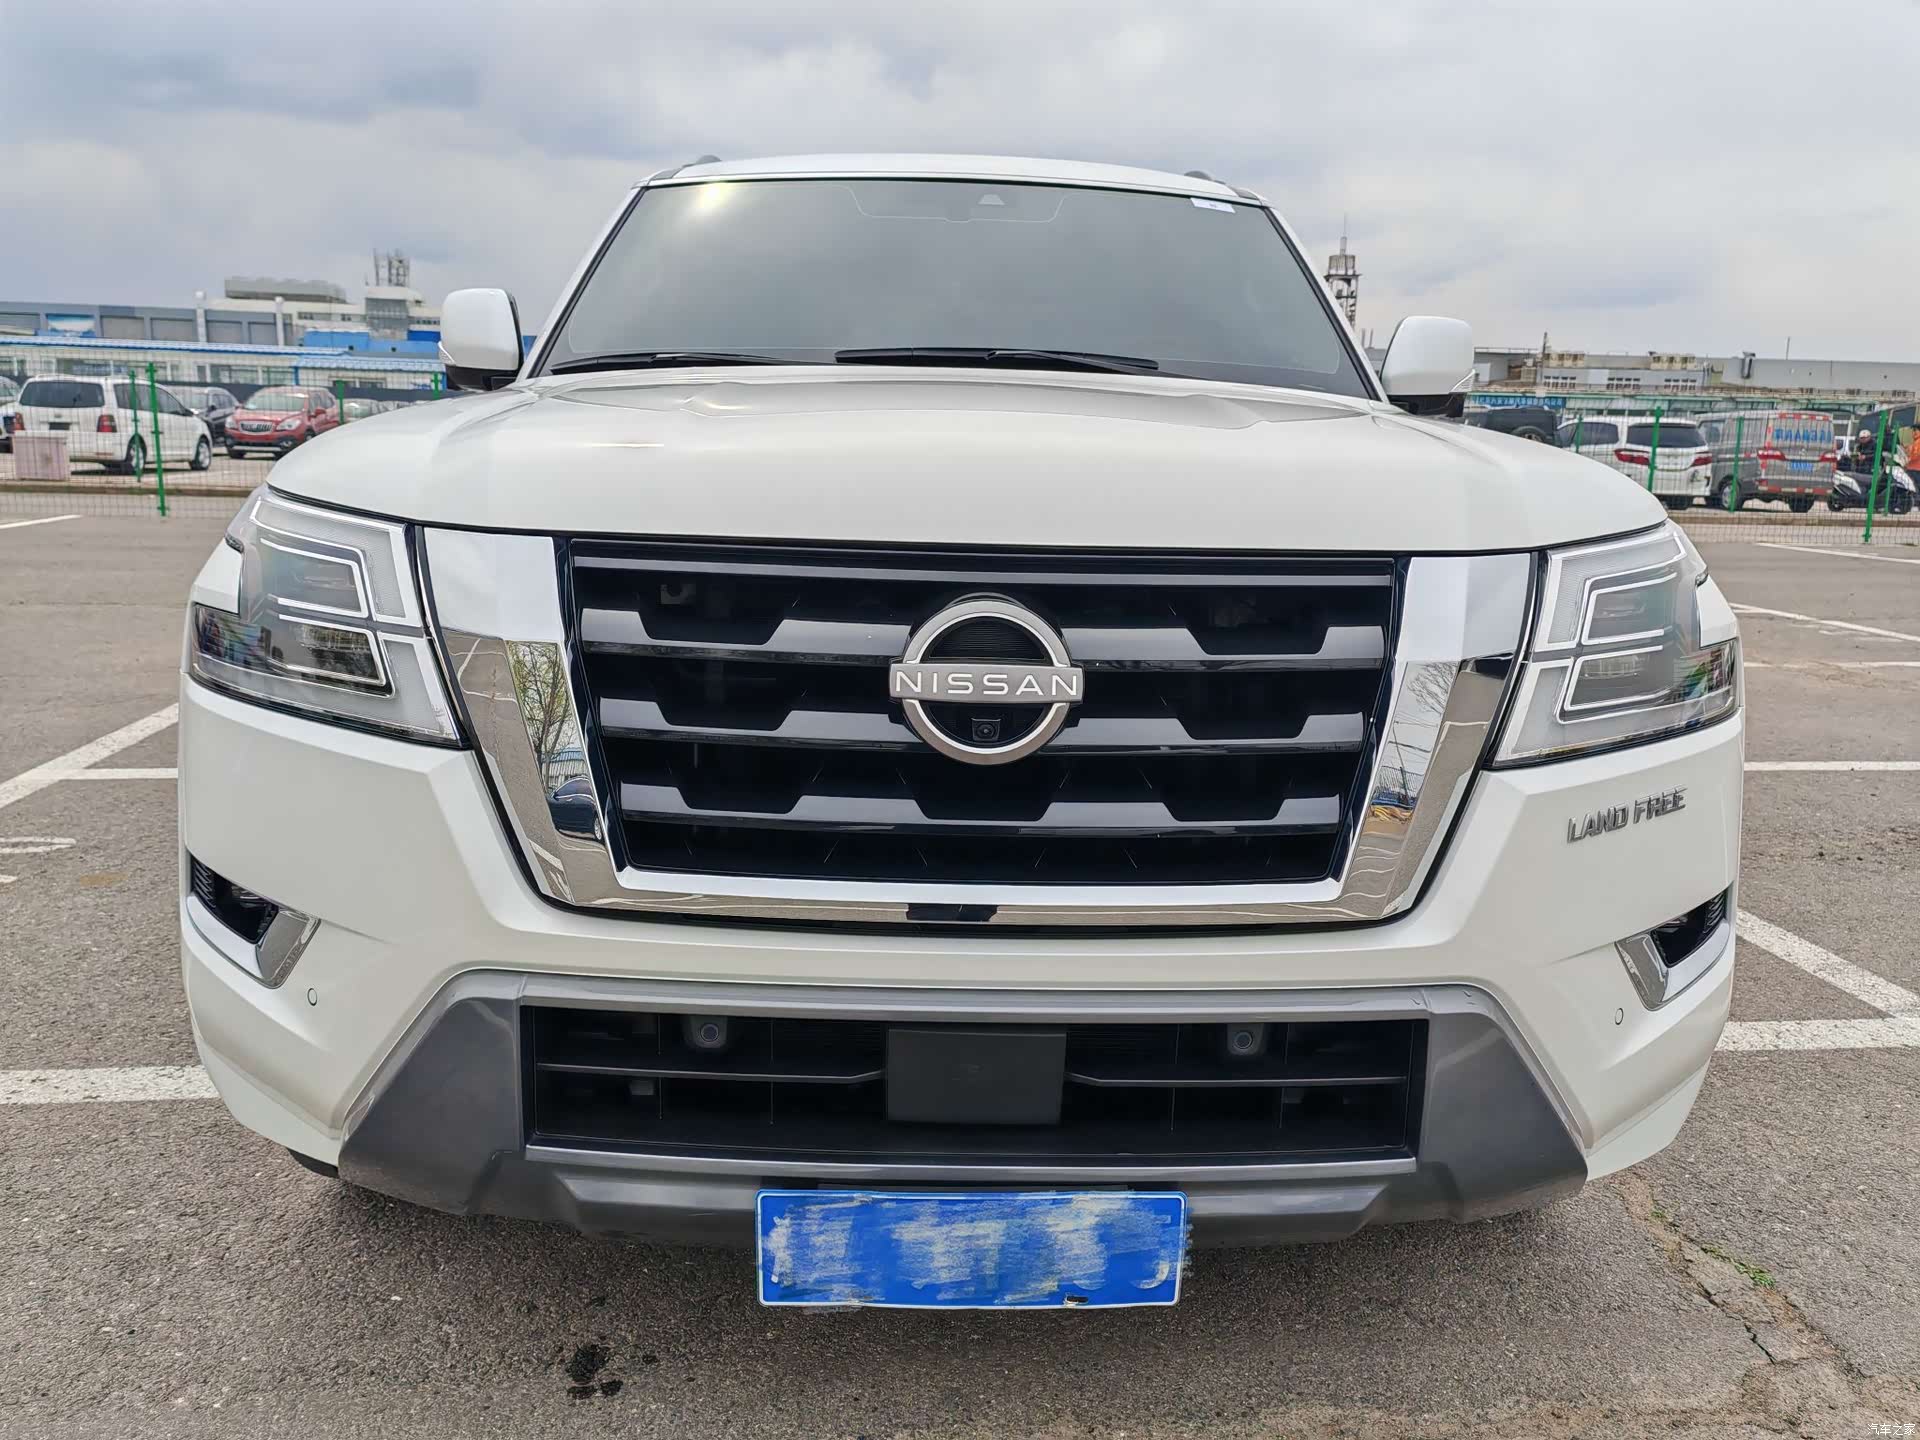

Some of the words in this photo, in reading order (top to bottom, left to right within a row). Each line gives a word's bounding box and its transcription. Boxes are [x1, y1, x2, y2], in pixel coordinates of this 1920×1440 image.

[895, 671, 1077, 696] NISSAN
[1567, 803, 1629, 843] LAND
[1633, 784, 1687, 824] FREE
